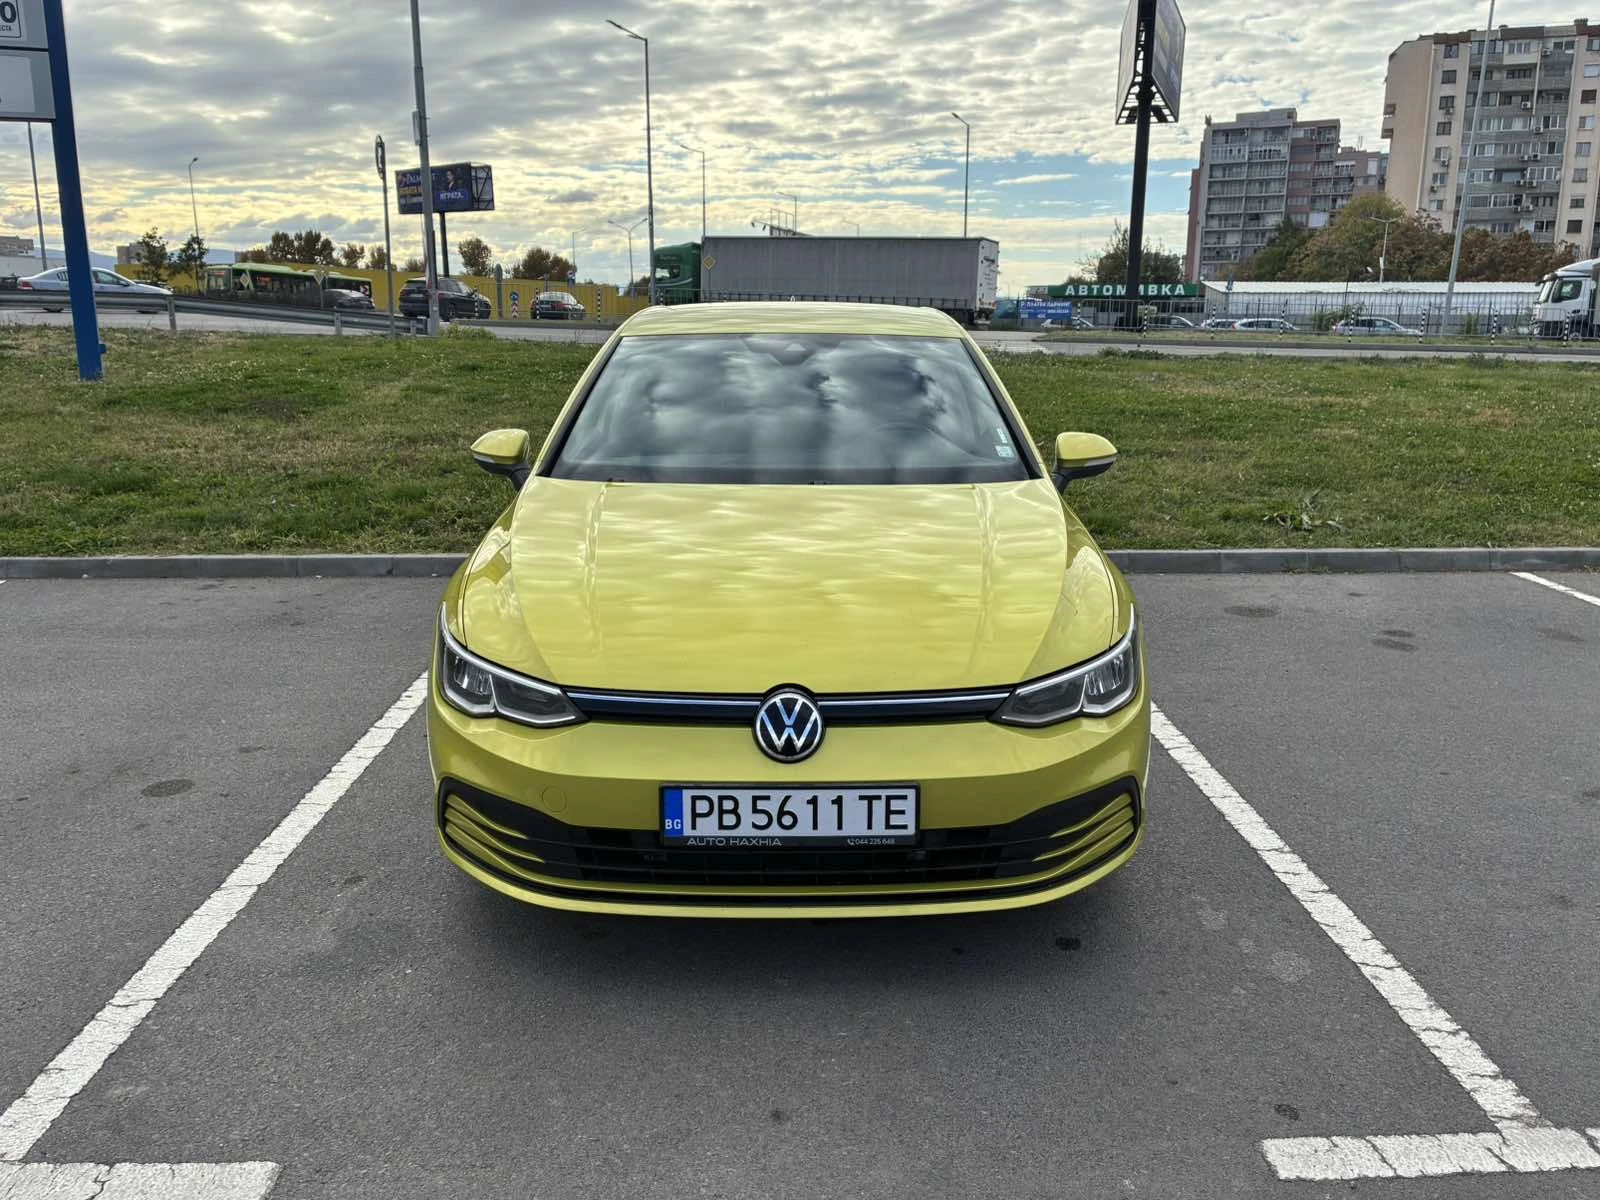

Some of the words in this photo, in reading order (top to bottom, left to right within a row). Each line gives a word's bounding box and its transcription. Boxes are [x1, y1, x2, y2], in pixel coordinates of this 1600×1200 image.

[759, 695, 820, 754] VW
[664, 819, 682, 830] BG
[687, 837, 726, 846] AUTO
[729, 837, 782, 846] HAXHIA
